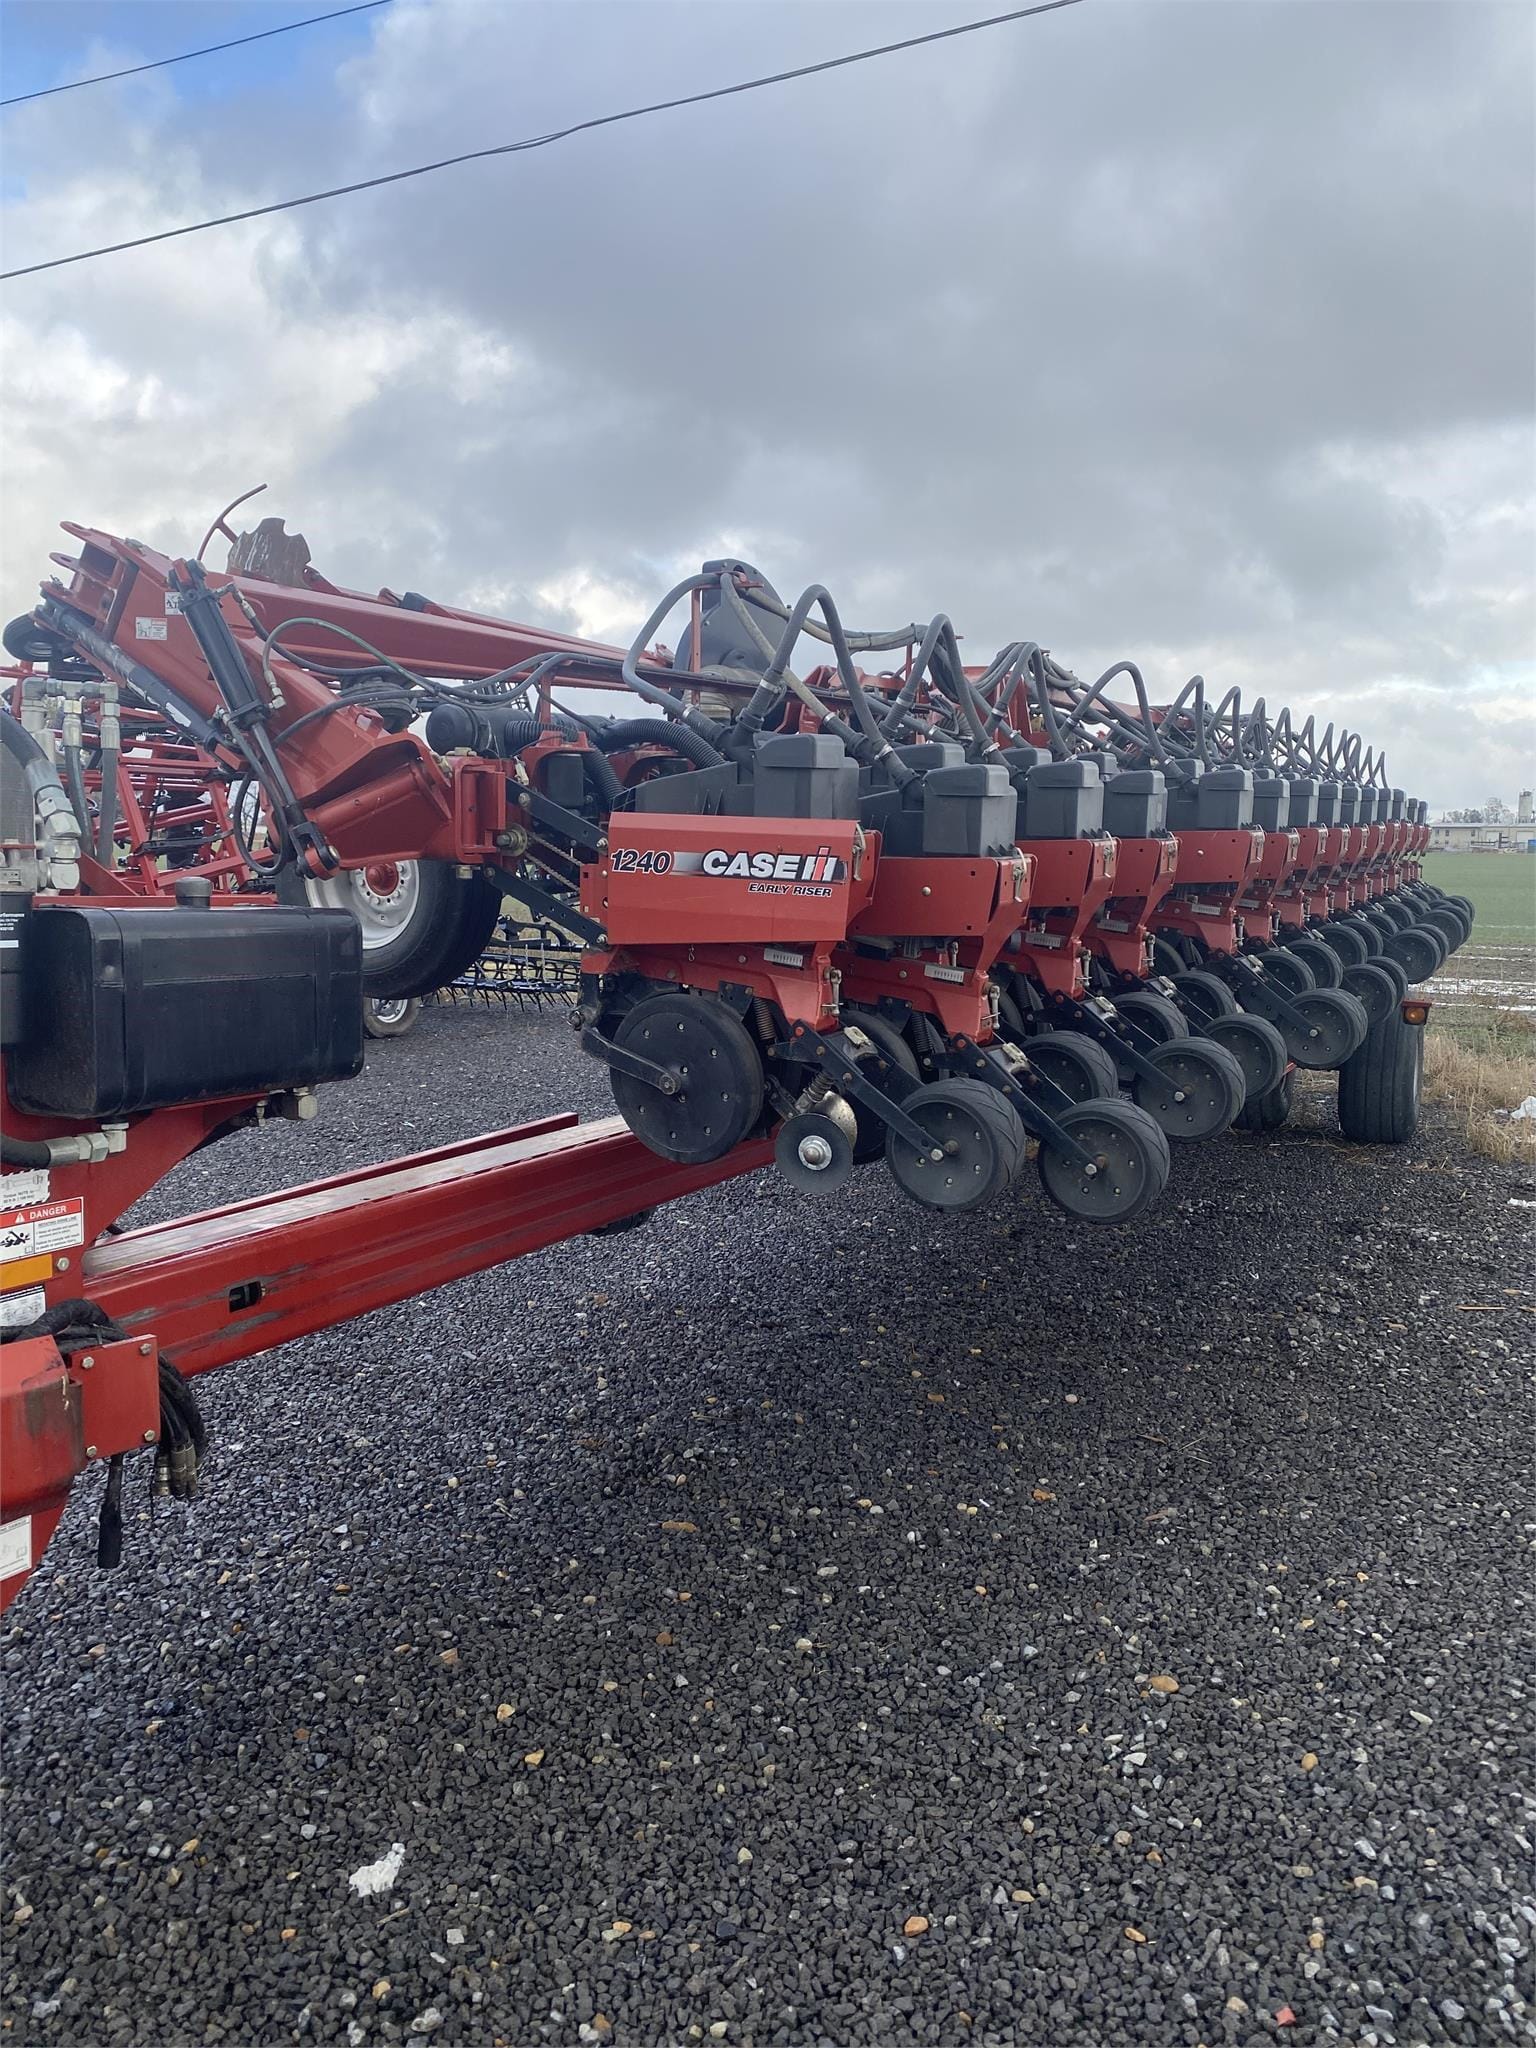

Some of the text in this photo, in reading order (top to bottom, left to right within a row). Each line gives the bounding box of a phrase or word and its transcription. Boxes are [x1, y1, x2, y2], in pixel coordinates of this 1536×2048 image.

[611, 849, 672, 874] 1240
[702, 850, 800, 880] CASE
[749, 883, 833, 897] EARLY RISER
[29, 1205, 67, 1220] DANGER
